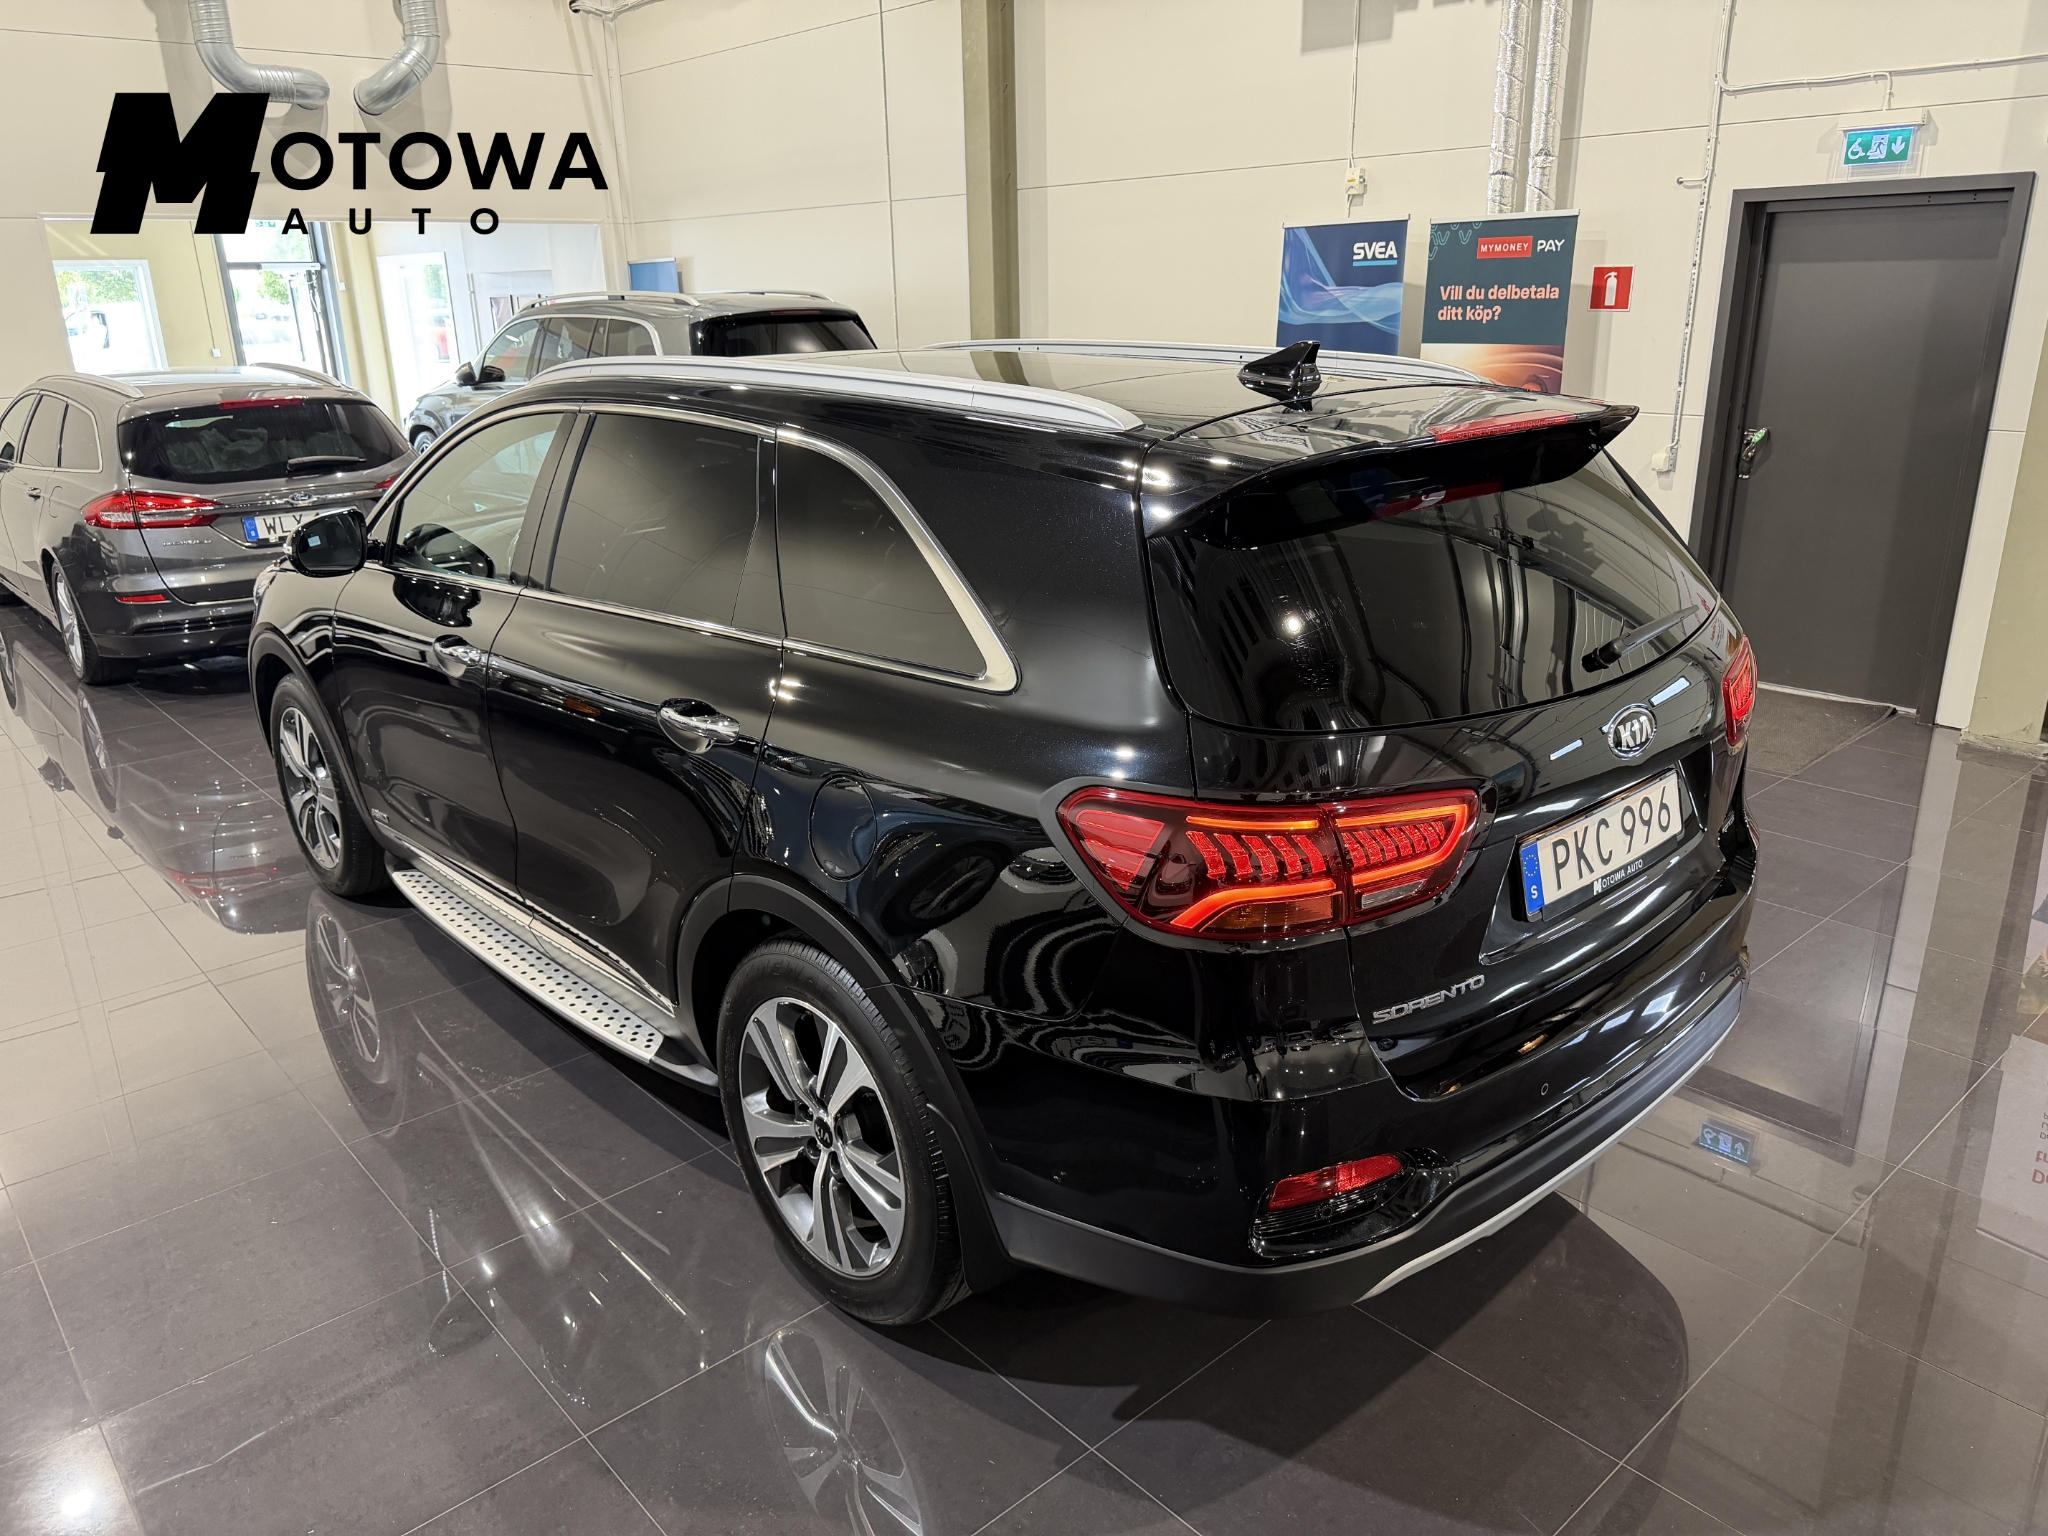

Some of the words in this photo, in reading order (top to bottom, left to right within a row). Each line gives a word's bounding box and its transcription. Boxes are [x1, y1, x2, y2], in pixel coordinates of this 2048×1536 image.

[1352, 241, 1398, 260] SVEA
[1480, 242, 1529, 253] MYMONEY
[1537, 239, 1565, 252] PAY
[1440, 285, 1463, 300] Vill
[1466, 285, 1485, 300] du
[1488, 284, 1560, 300] delbetala
[1437, 307, 1463, 321] ditt
[1466, 305, 1502, 324] köp?
[1618, 715, 1652, 750] KIA
[1551, 817, 1614, 892] PKC
[1621, 786, 1671, 855] 996
[1593, 869, 1626, 896] MOTOWA
[1627, 859, 1643, 875] AUTO
[1530, 885, 1538, 899] S
[1372, 974, 1485, 1025] SORENTO
[815, 1124, 831, 1144] KIA
